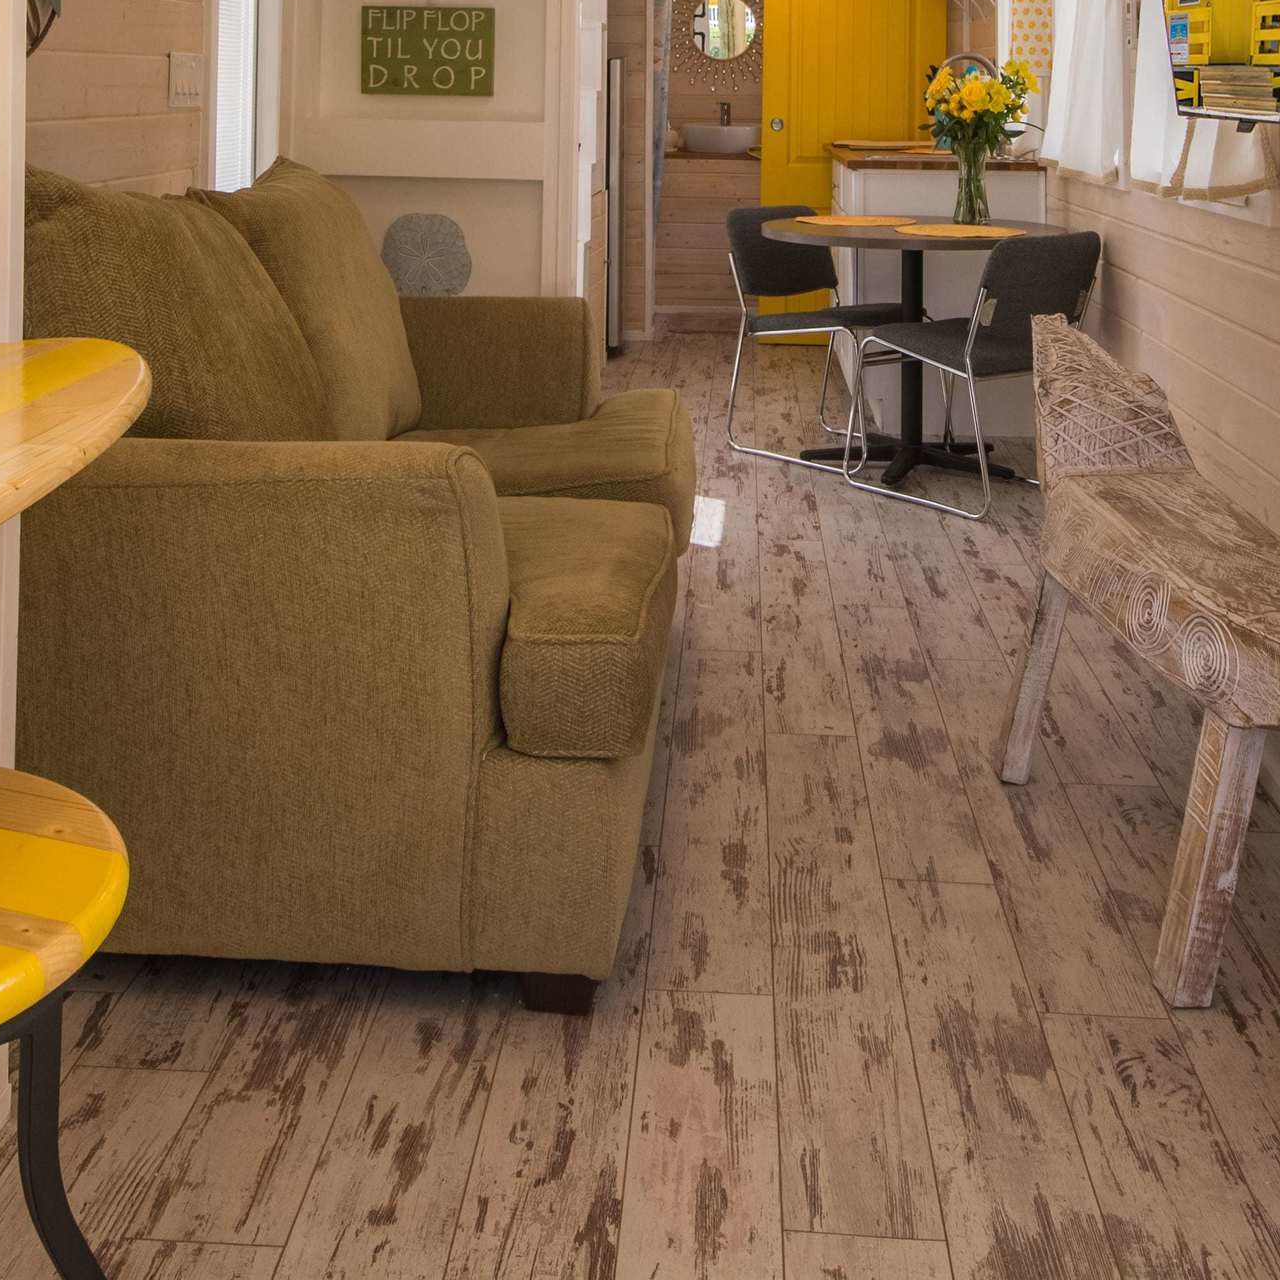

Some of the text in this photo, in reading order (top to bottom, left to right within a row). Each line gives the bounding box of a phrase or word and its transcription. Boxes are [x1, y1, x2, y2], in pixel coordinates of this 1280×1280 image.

[368, 9, 485, 31] FLIP FLOP
[367, 36, 483, 60] TIL YOU
